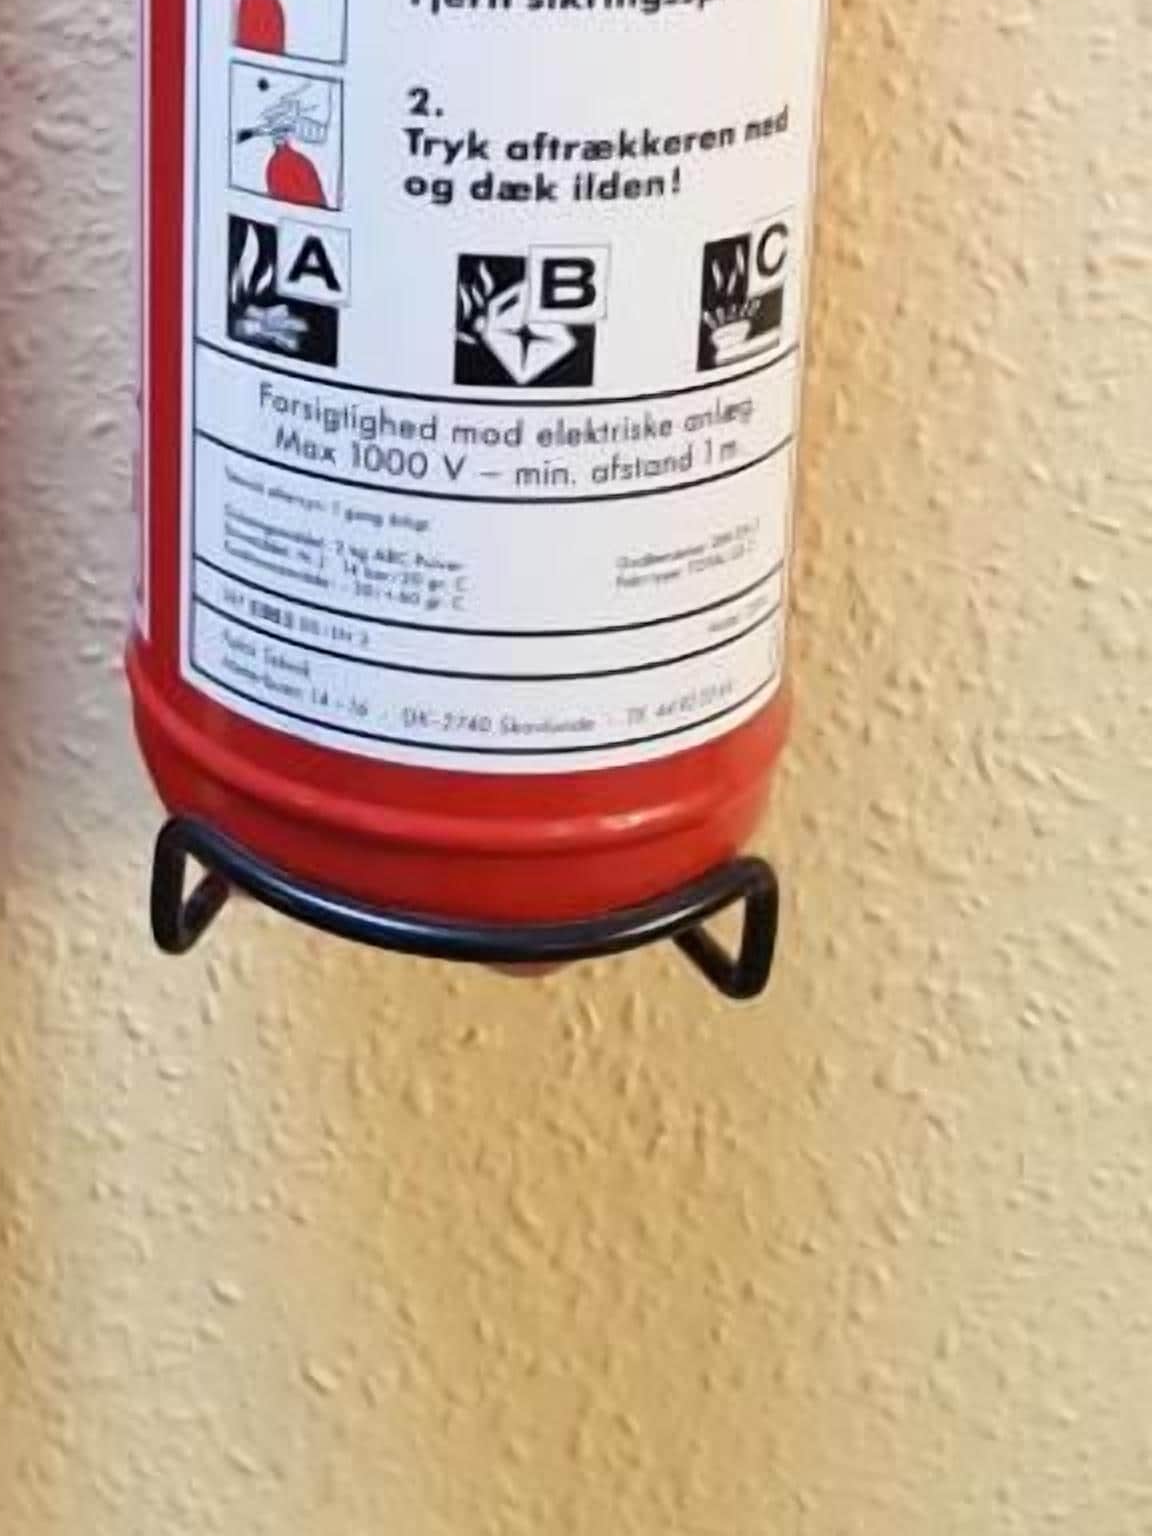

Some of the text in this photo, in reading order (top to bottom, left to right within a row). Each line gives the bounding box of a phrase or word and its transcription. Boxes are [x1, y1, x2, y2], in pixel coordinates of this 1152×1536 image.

[407, 85, 445, 119] 2.
[403, 103, 790, 165] Tryk aftrækkeren ned
[404, 165, 681, 206] og dæk ilden!
[287, 222, 790, 310] A B C
[259, 381, 438, 442] Forsigtighed
[452, 417, 525, 448] mod
[536, 408, 674, 449] elektriske
[275, 425, 337, 465] Max
[351, 439, 429, 480] 1000
[442, 453, 468, 481] V
[515, 458, 577, 486] min.
[591, 443, 694, 485] afstand
